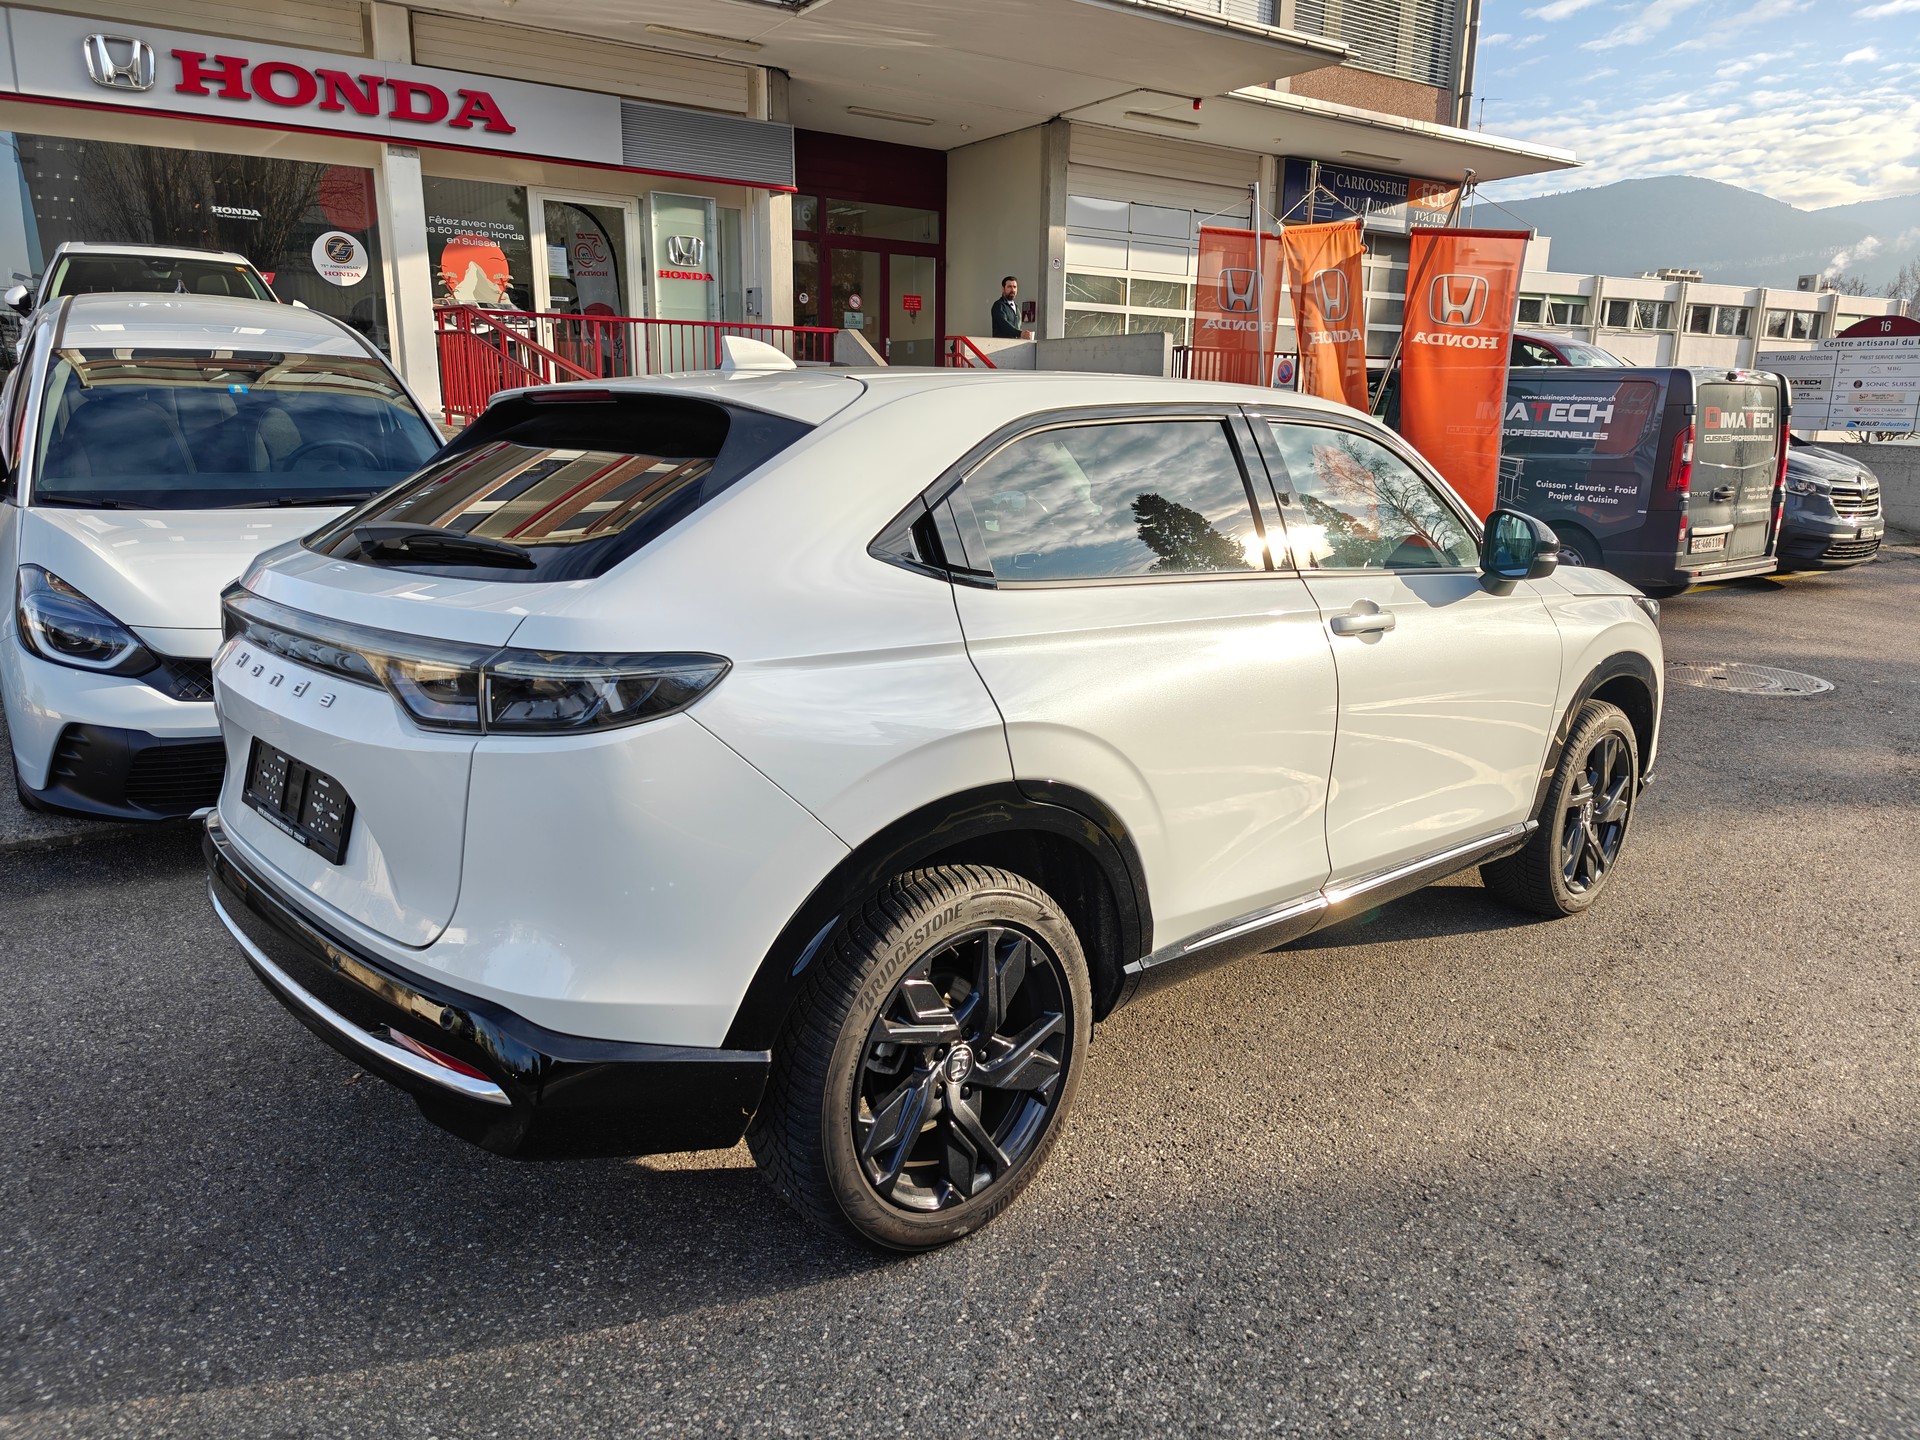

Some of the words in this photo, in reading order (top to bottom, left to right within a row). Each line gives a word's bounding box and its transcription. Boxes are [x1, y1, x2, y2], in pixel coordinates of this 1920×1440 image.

[171, 49, 516, 134] HONDA
[1336, 173, 1408, 197] CARROSSERIE
[1344, 195, 1358, 211] DU
[211, 205, 262, 217] HONDA
[795, 205, 812, 222] 16
[1415, 210, 1448, 224] TOUTES
[428, 215, 460, 226] Fêtez
[461, 219, 487, 228] avec
[488, 221, 515, 231] nous
[425, 226, 436, 234] es
[437, 226, 453, 235] 50
[454, 228, 475, 237] ans
[475, 229, 490, 238] de
[491, 230, 525, 241] Honda
[446, 237, 461, 245] en
[323, 270, 361, 278] HONDA
[658, 270, 716, 282] HONDA
[1880, 320, 1892, 332] 16
[1310, 328, 1363, 345] HONDA
[1823, 340, 1854, 348] Centre
[1856, 338, 1899, 347] artisanal
[1902, 338, 1914, 346] du
[1521, 394, 1616, 403] www.cuisineprodepannage.ch
[1705, 406, 1774, 429] DIMATECH
[1502, 428, 1609, 441] ROFESSIONNELLES
[1705, 435, 1731, 443] CUISINES
[1535, 479, 1567, 490] Cuisson
[1574, 483, 1606, 493] Laverie
[1614, 486, 1637, 495] Froid
[1547, 492, 1573, 502] Projet
[1574, 493, 1585, 502] de
[1587, 494, 1619, 504] Cuisine
[235, 651, 338, 709] Honda
[857, 902, 964, 1017] BRIDGESTONE
